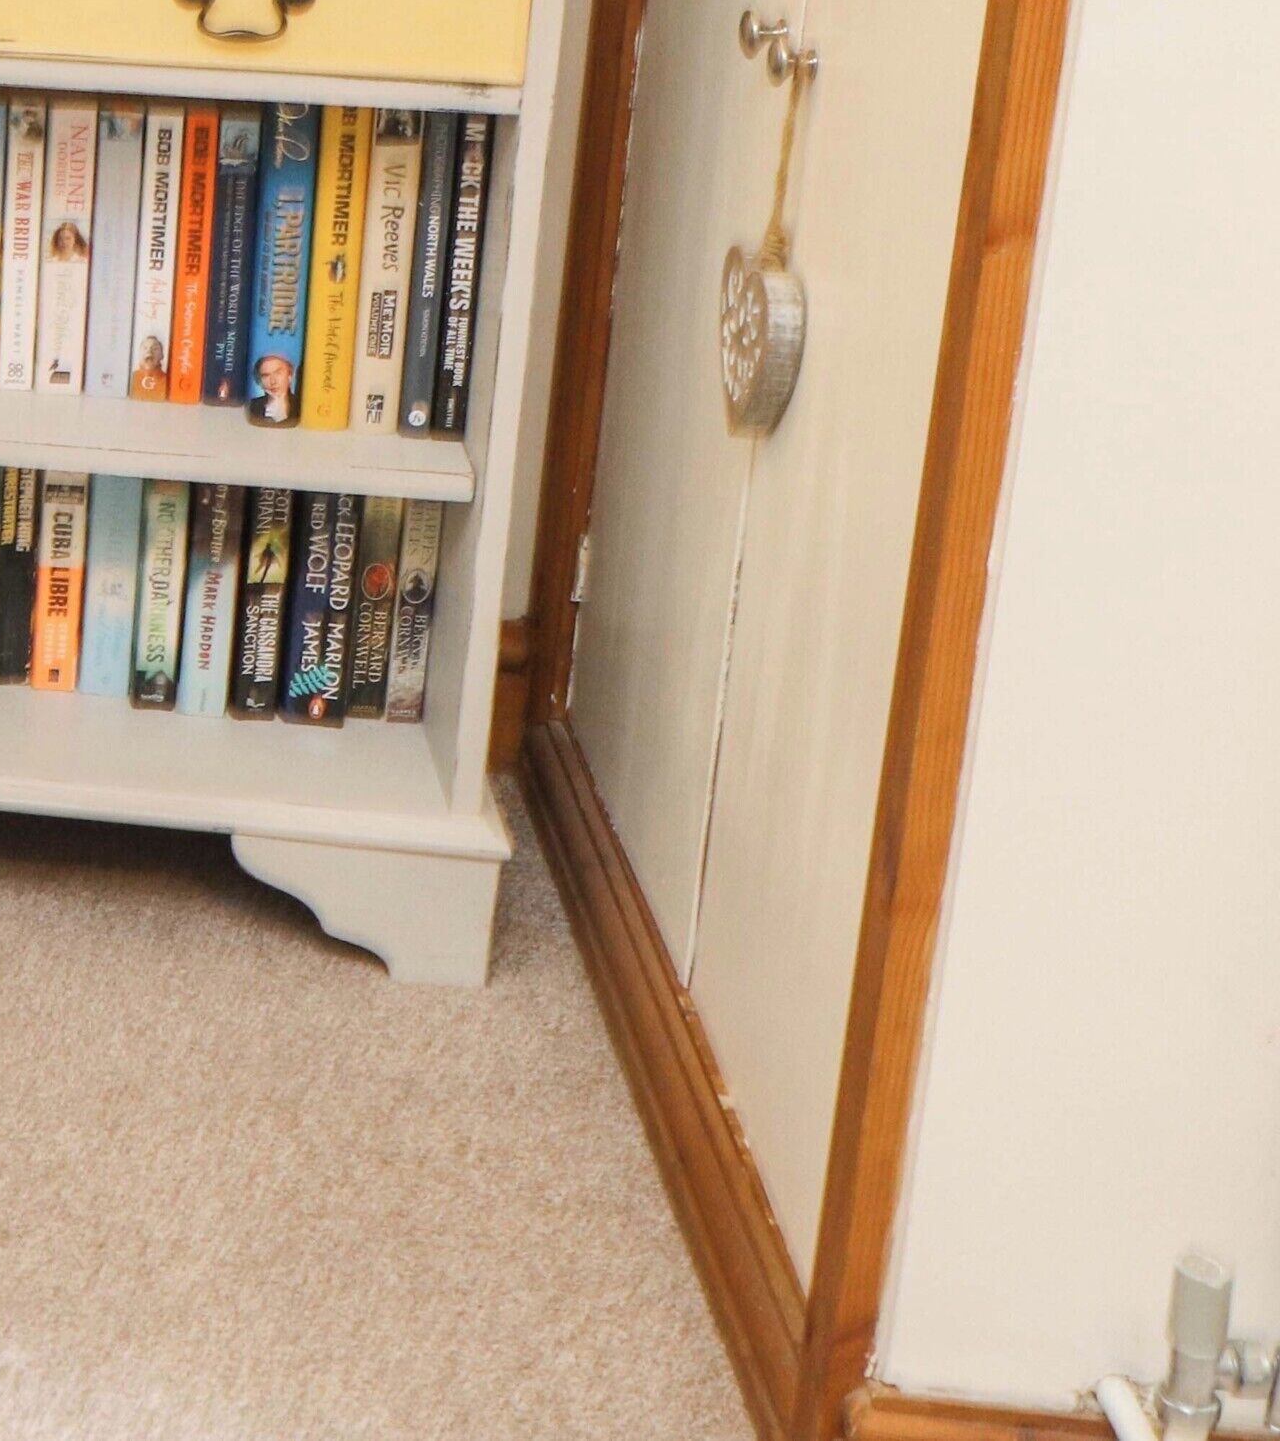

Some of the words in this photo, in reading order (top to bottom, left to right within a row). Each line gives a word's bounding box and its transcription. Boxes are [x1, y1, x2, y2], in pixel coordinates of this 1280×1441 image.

[65, 124, 90, 212] NADINE
[156, 127, 173, 166] BOB
[193, 126, 210, 167] BOB
[459, 122, 487, 190] MCK
[54, 141, 69, 198] DORRIES
[235, 177, 248, 202] THE
[330, 134, 357, 246] MORTIMER
[382, 164, 406, 199] Vic
[14, 181, 32, 211] WAR
[454, 192, 481, 232] THE
[12, 217, 30, 261] BRIDE
[148, 171, 171, 272] MORTIMER
[185, 170, 209, 277] MORTIMER
[232, 205, 246, 237] EDGE
[380, 206, 404, 273] Reeves
[424, 215, 439, 258] NORTH
[229, 259, 243, 279] THE
[232, 239, 244, 256] OF
[14, 269, 25, 319] PAMELA
[267, 209, 304, 337] PARTRIDGE
[420, 259, 438, 300] WALES
[447, 237, 476, 312] WEEK'S
[227, 284, 241, 325] WORLD
[368, 295, 380, 331] VOLUME
[446, 316, 458, 329] OF
[215, 343, 225, 360] PYE
[223, 332, 237, 373] MICHAEL
[442, 348, 455, 371] TIME
[444, 330, 457, 347] ALL
[453, 317, 468, 360] FUNNIEST
[451, 361, 466, 387] BOOK
[158, 502, 177, 523] NO
[255, 489, 274, 535] RIANI
[276, 489, 290, 523] COTT
[310, 503, 325, 529] RED
[14, 520, 33, 553] KING
[49, 511, 74, 560] CUBA
[154, 526, 176, 578] THER
[304, 535, 329, 594] WOLF
[328, 521, 357, 611] LEOPARD
[47, 567, 71, 617] LIBRE
[201, 571, 223, 609] MARK
[260, 592, 280, 613] THE
[197, 615, 218, 670] HADDON
[240, 604, 259, 676] SANCTION
[253, 618, 279, 683] CASSANDRA
[300, 620, 321, 673] JAMES
[351, 602, 372, 689] CORNWELL
[367, 610, 387, 683] BERNARD
[321, 623, 345, 701] MARLON
